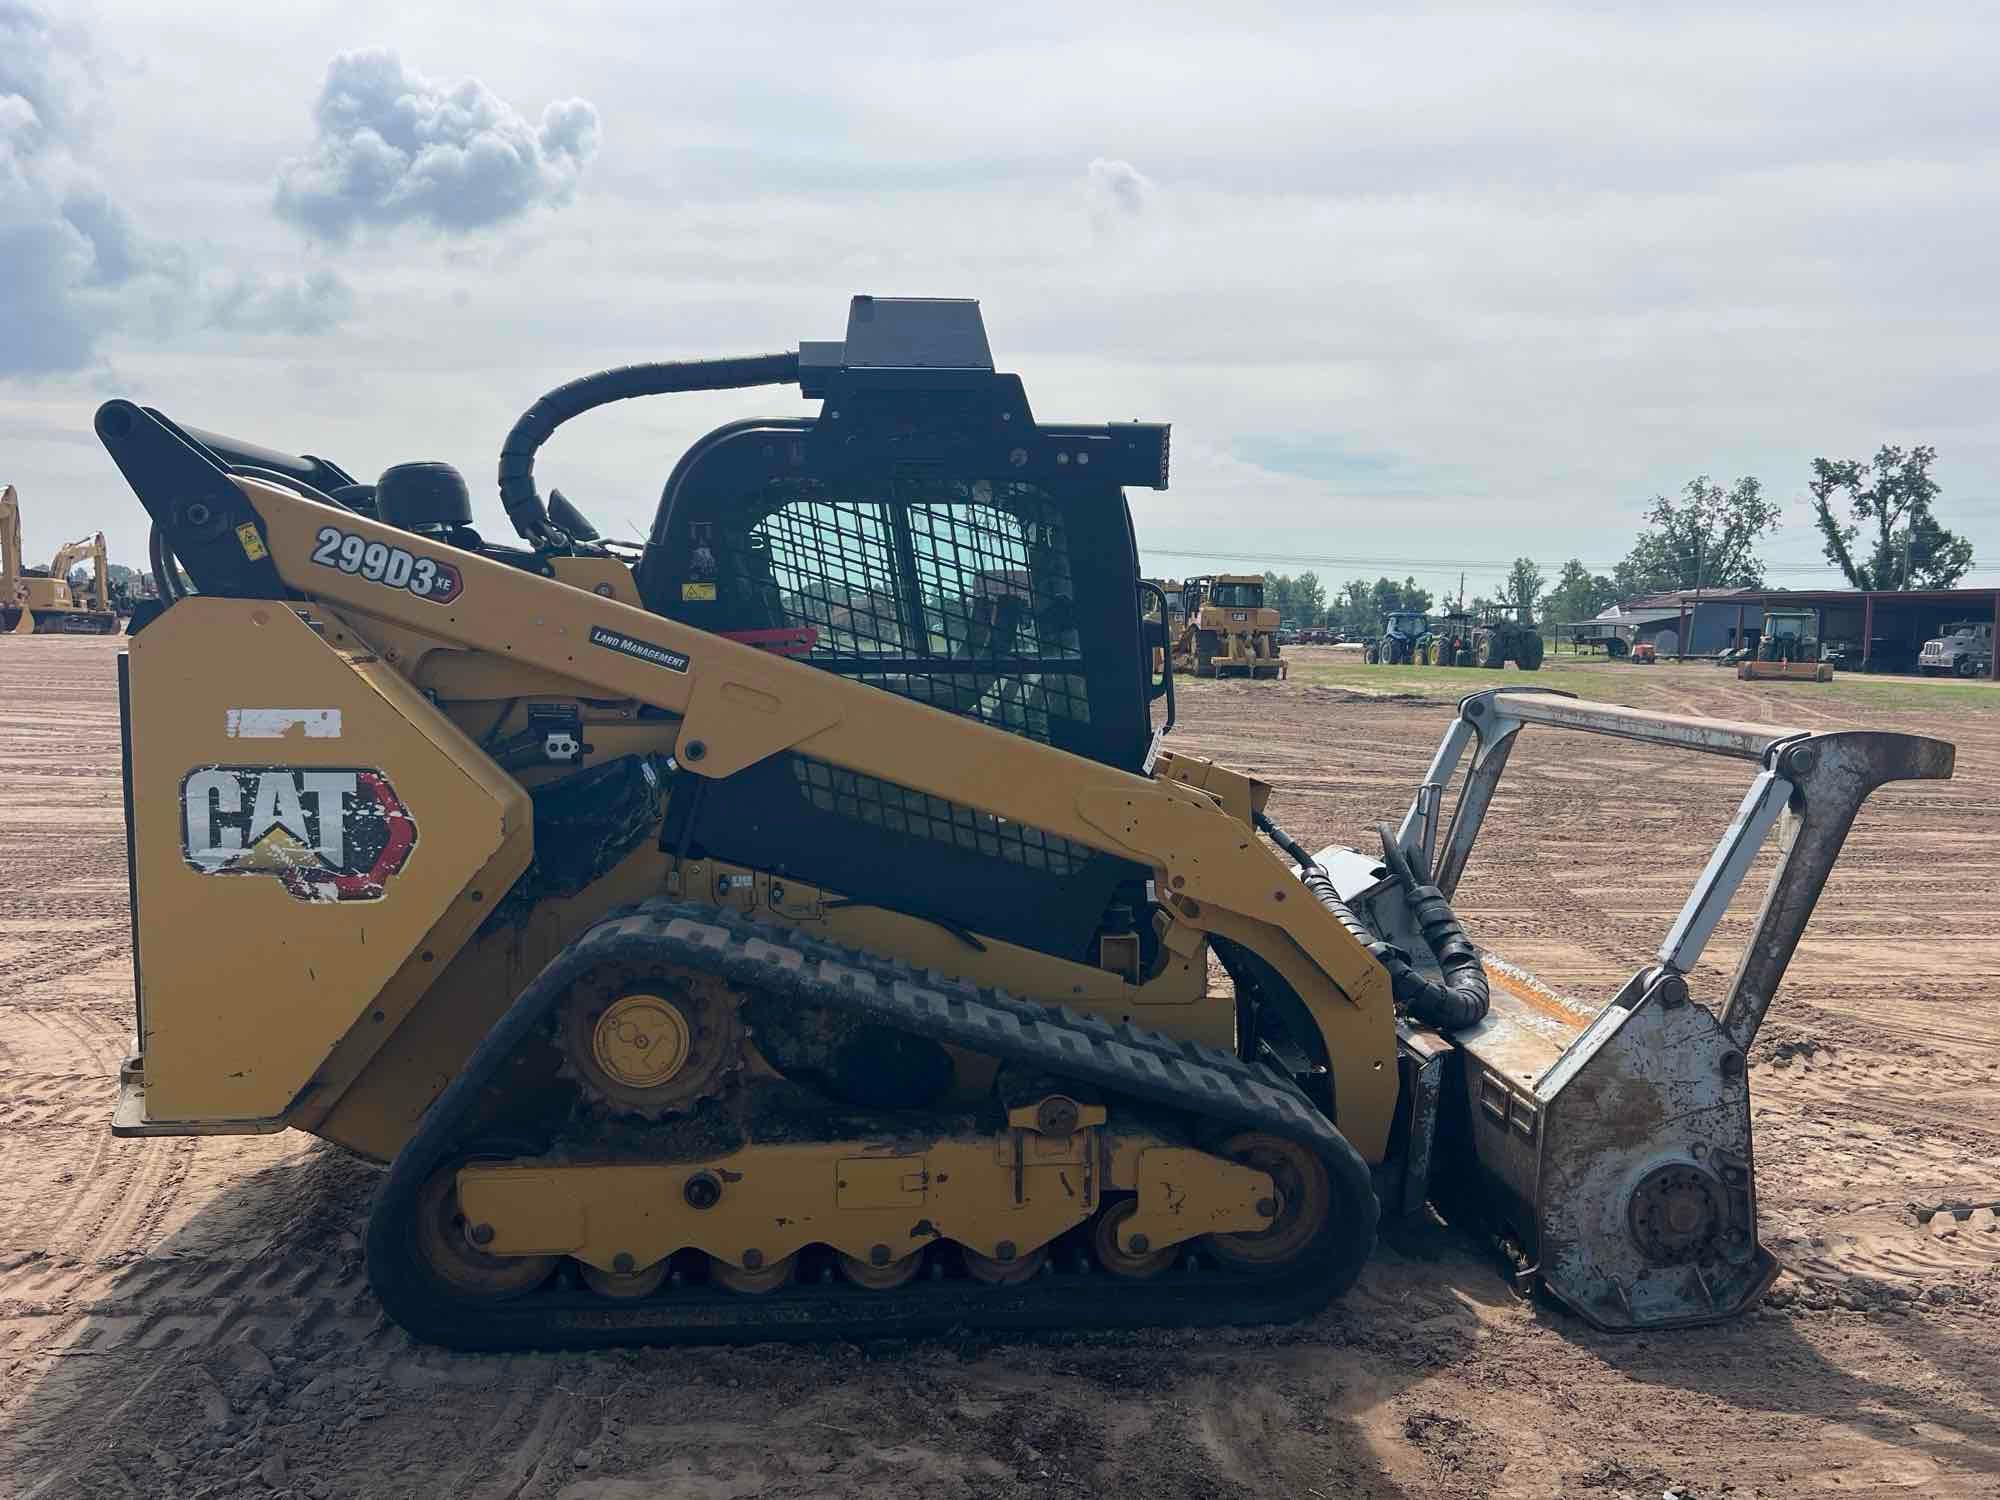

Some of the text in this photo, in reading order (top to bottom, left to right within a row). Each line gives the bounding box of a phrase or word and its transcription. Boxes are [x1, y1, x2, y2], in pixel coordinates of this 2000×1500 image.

[312, 527, 438, 595] 299D3
[435, 576, 452, 591] XE
[594, 631, 686, 668] LAND MANAGEMENT
[185, 768, 358, 869] CAT
